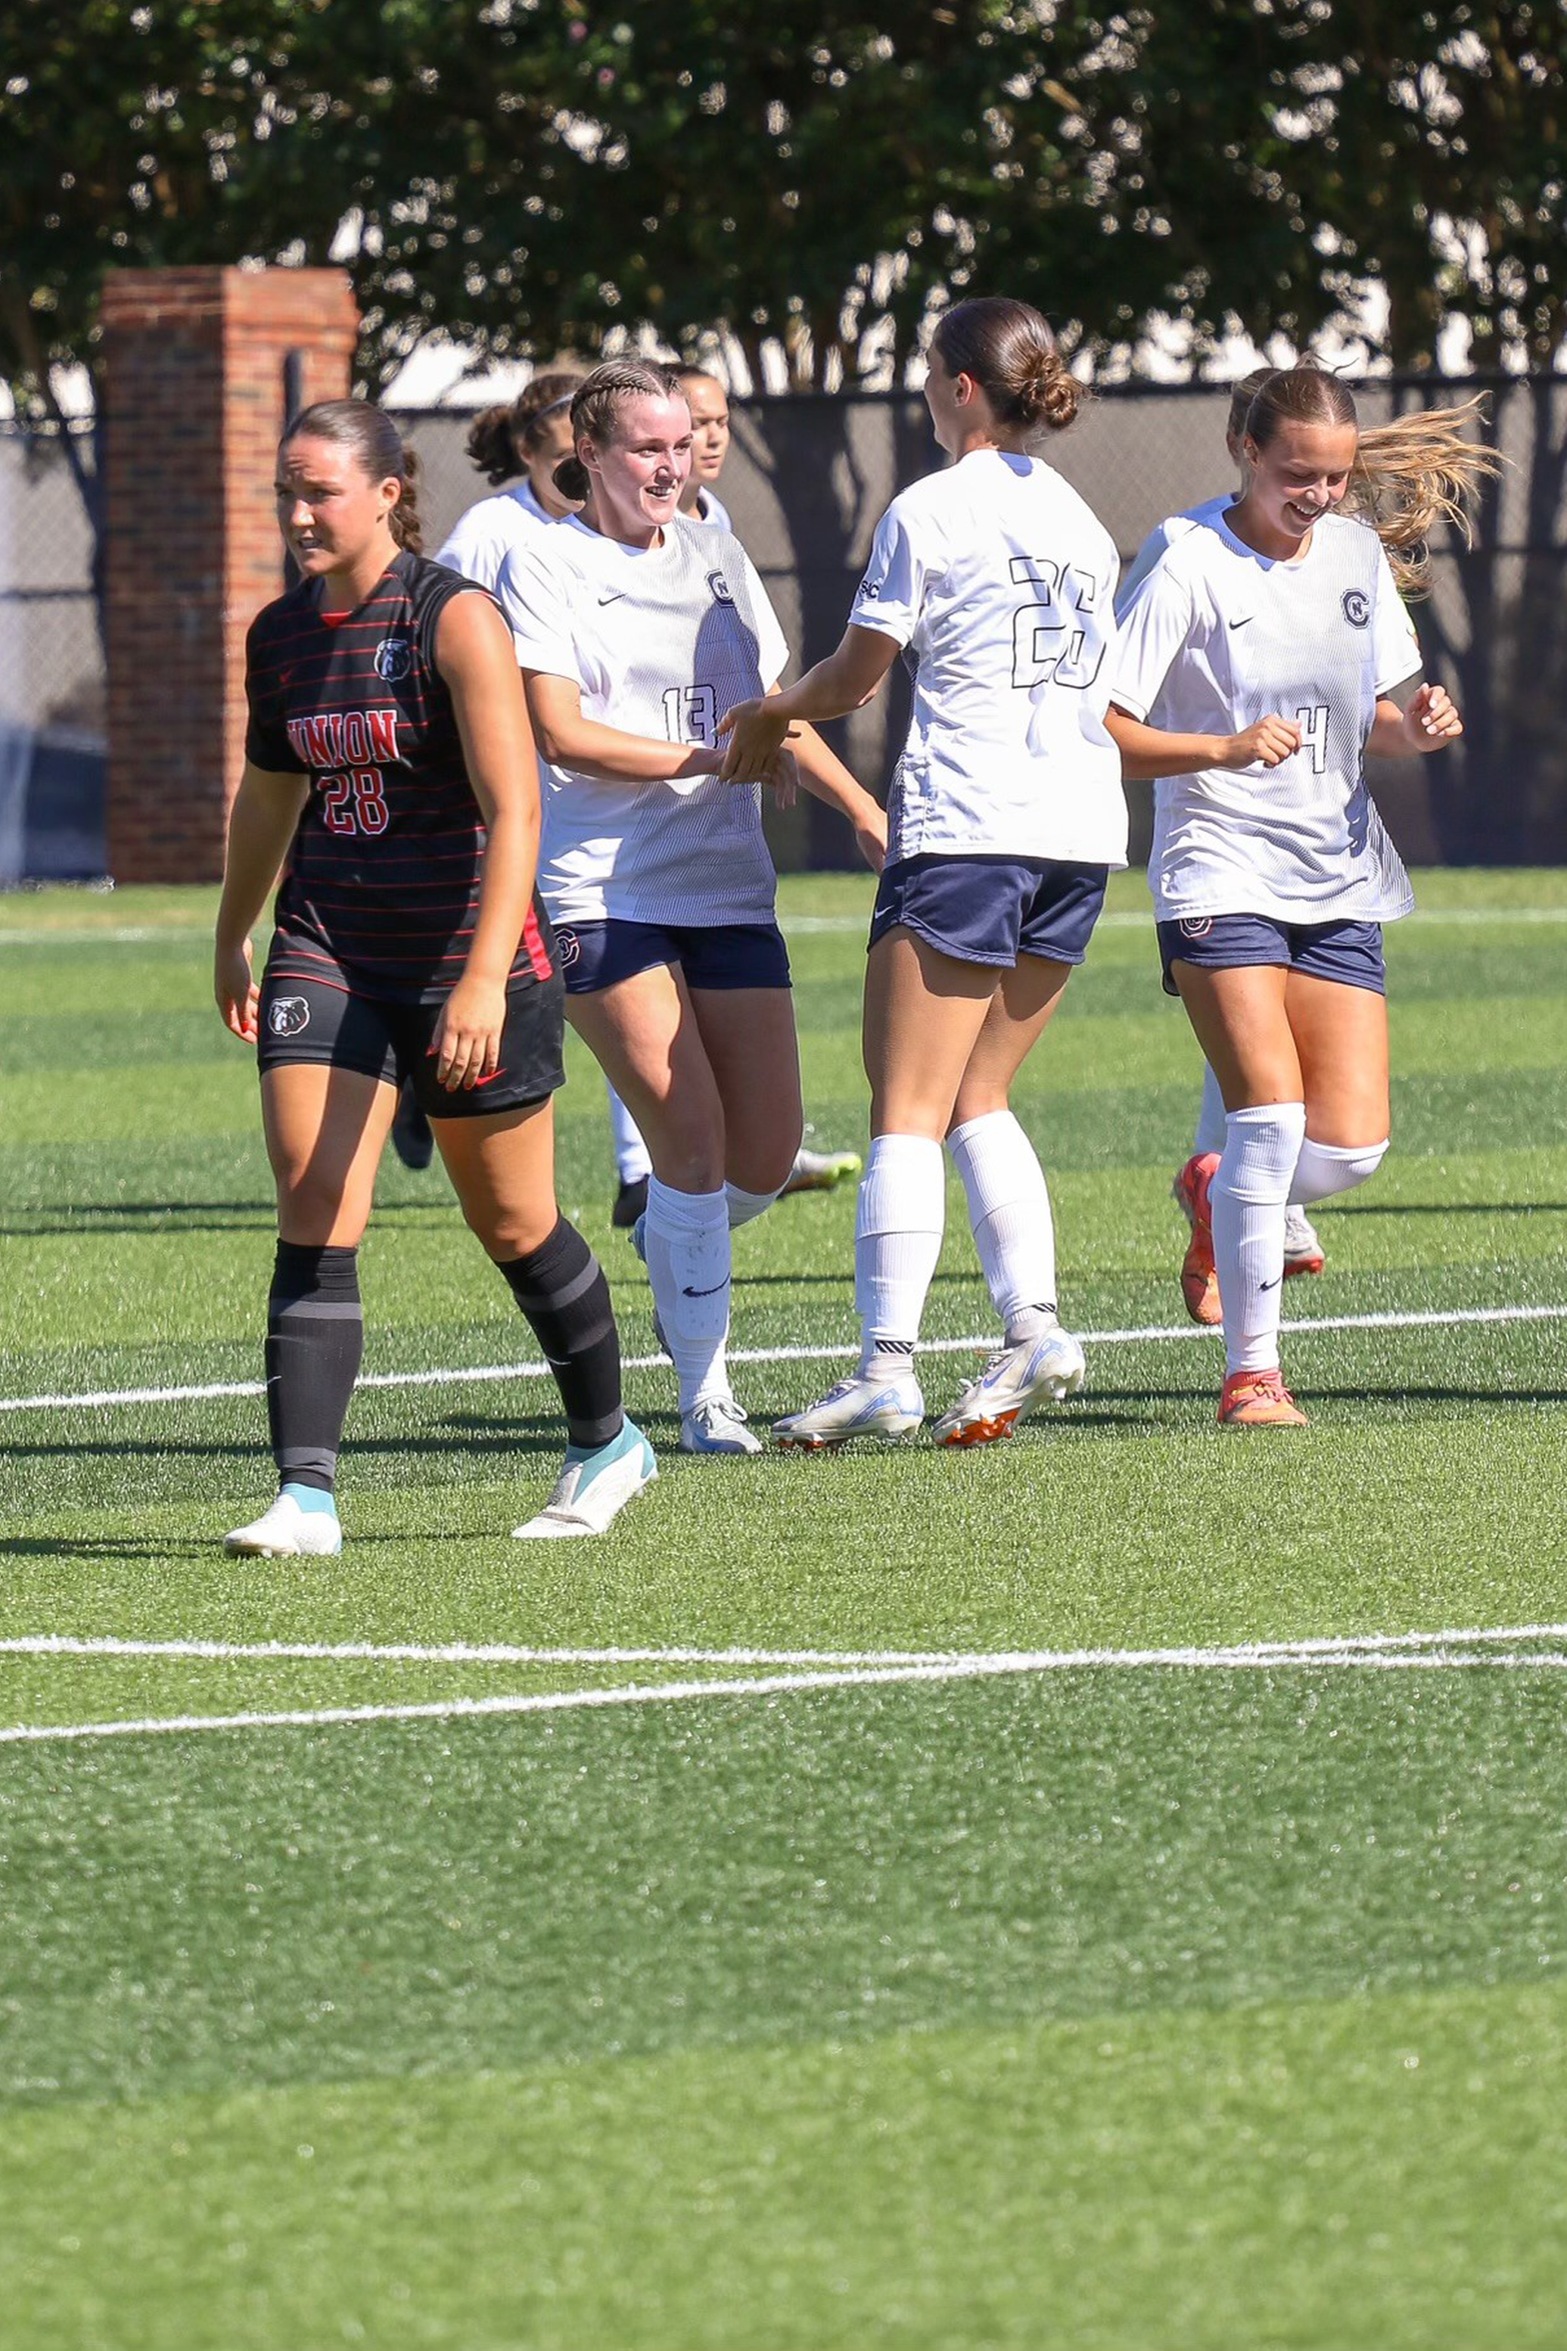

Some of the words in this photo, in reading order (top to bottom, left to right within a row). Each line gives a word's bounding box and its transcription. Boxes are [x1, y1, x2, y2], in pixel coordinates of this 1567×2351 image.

[1008, 556, 1106, 690] 26
[287, 709, 399, 768] UNION
[661, 684, 718, 749] 13
[1296, 705, 1329, 774] 4
[316, 766, 389, 835] 28
